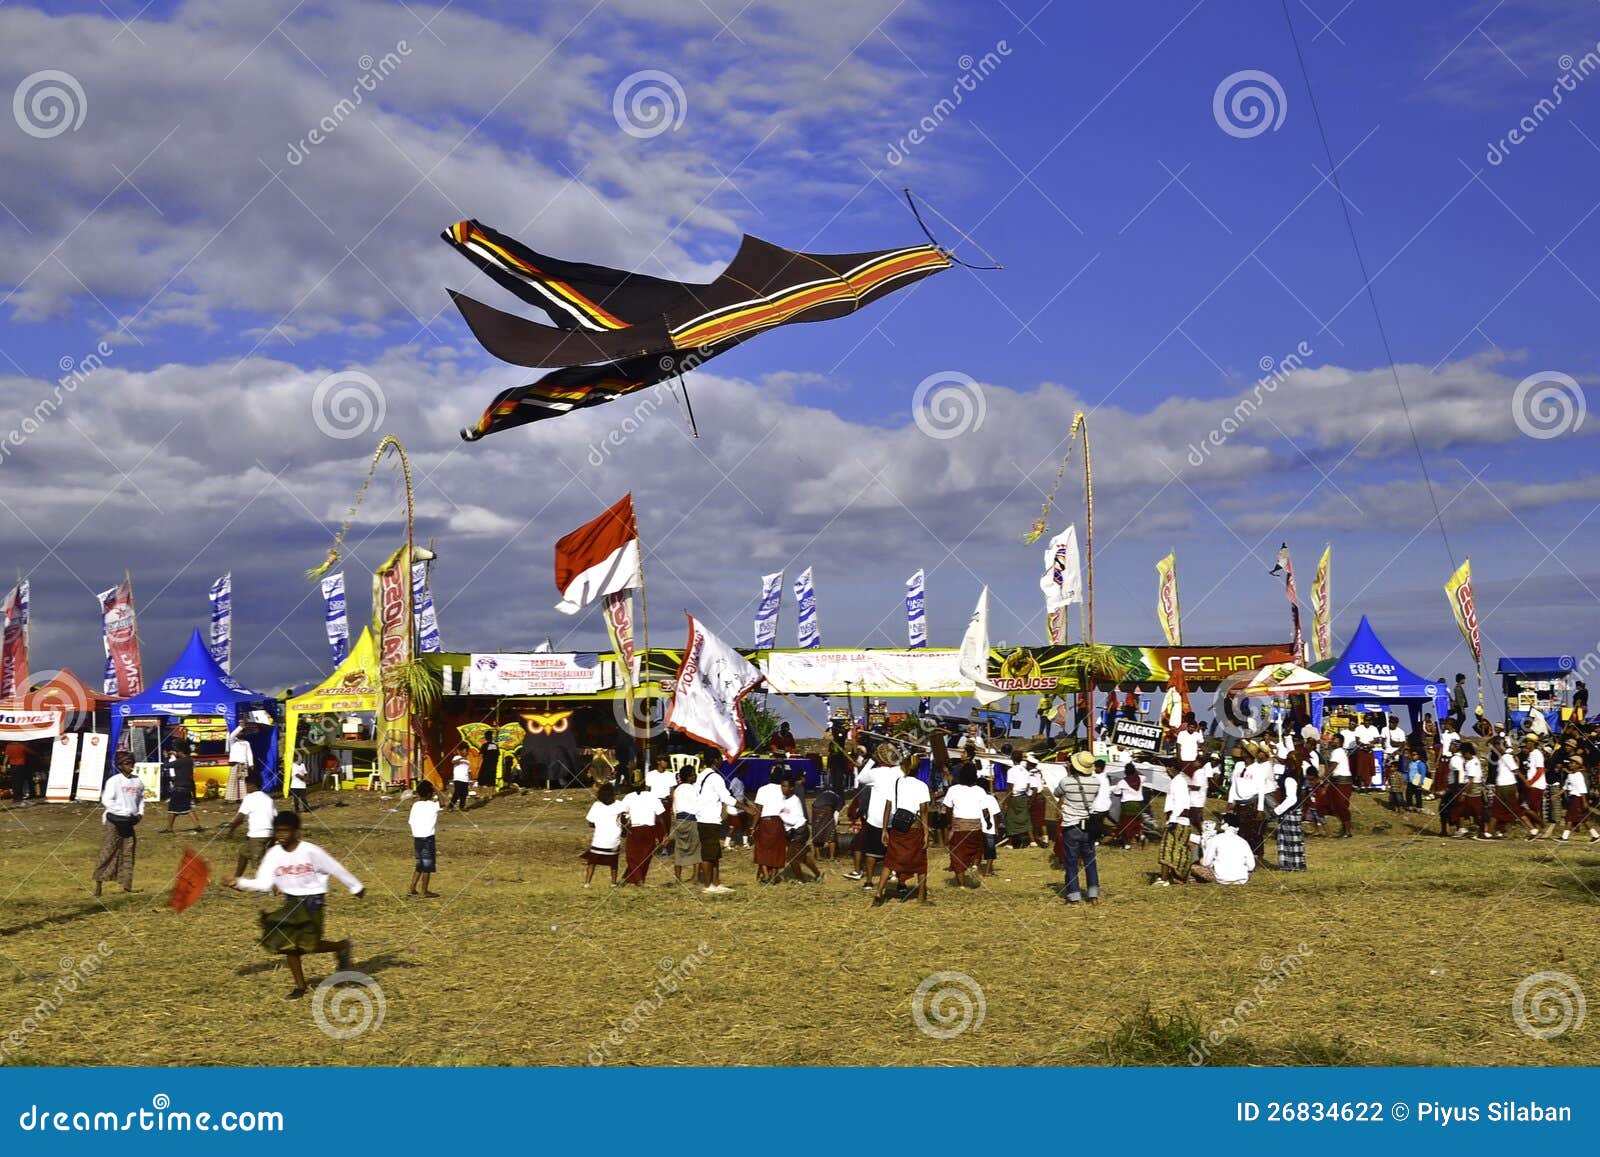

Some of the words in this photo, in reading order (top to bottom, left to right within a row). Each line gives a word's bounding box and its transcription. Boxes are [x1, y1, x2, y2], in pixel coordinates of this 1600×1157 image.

[1349, 662, 1396, 670] POCARI
[163, 677, 206, 686] POCARI
[1025, 678, 1057, 689] JOSS
[1117, 722, 1163, 738] BANGKET
[1117, 735, 1156, 750] KANGIN
